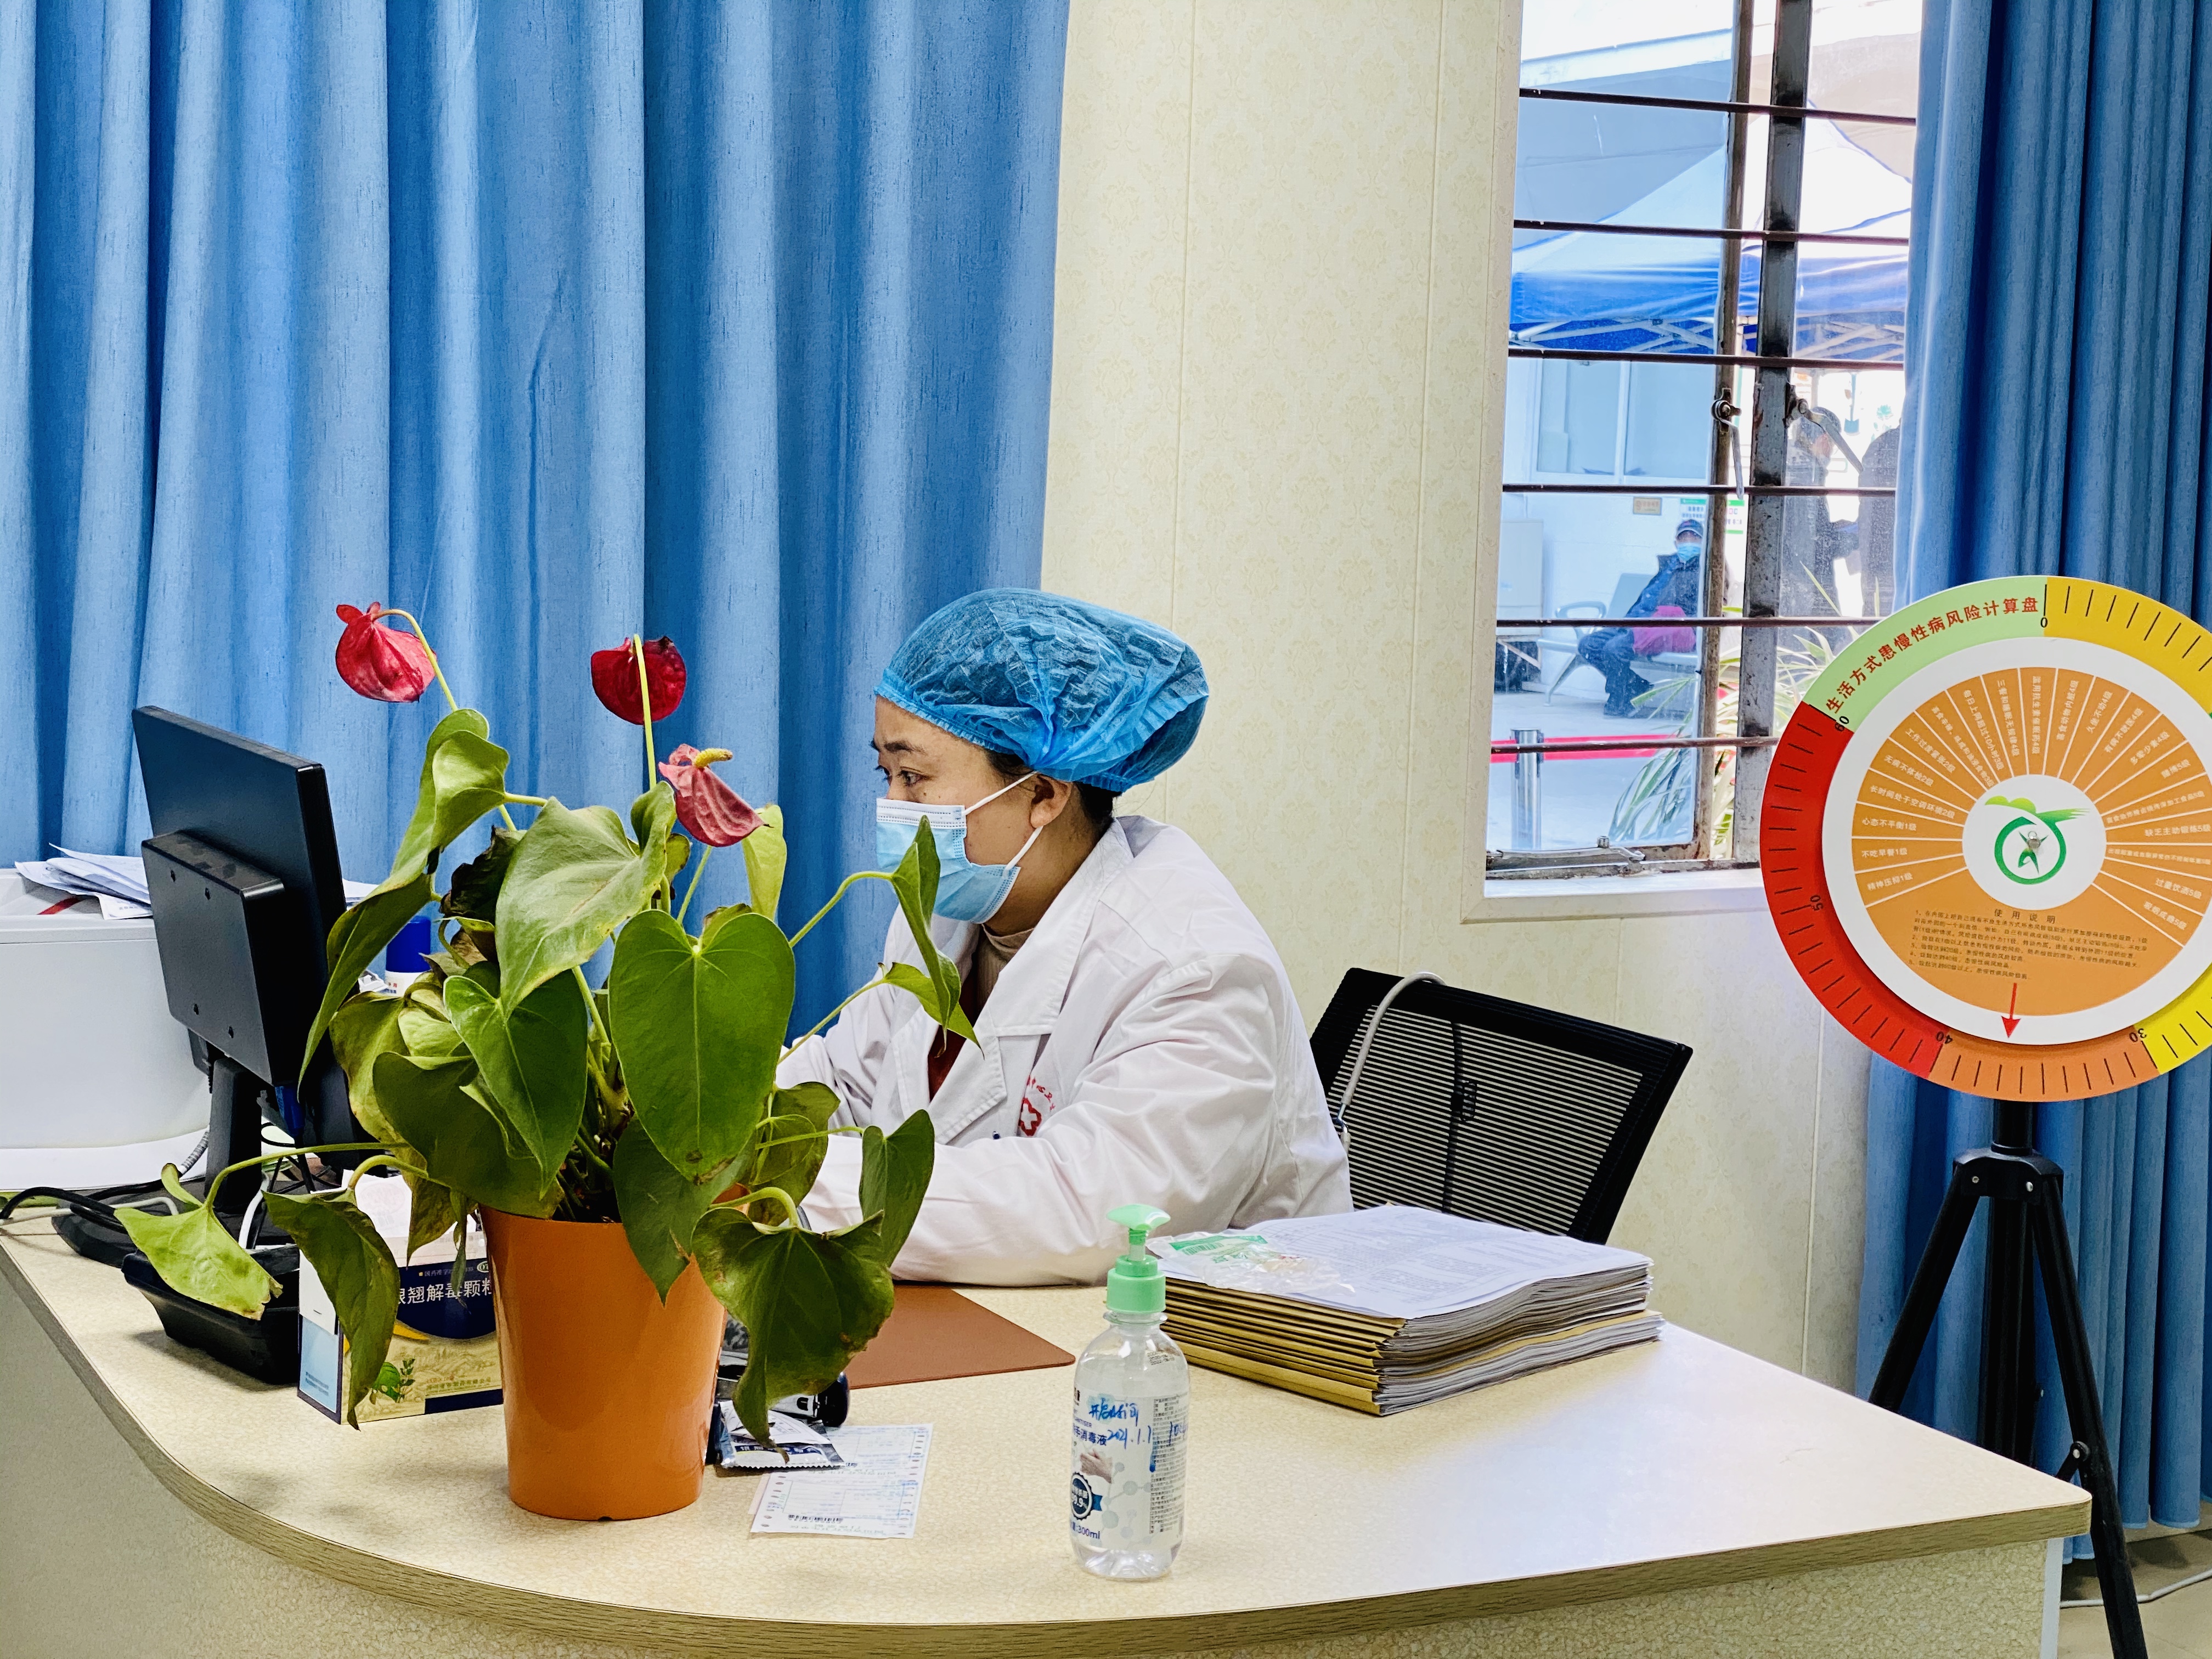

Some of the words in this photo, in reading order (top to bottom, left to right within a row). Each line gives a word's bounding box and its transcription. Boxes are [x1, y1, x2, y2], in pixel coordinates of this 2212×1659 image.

[2040, 617, 2047, 628] 0
[1826, 597, 2038, 713] 生活方式患慢性病风险计算盘
[1835, 715, 1850, 732] 60
[1869, 785, 1955, 819] 长时间处于空调环境2级
[1862, 818, 1917, 831] 心态不平衡1级
[2144, 823, 2211, 837] 缺乏主动锻炼5级
[1861, 848, 1908, 858] 不吃早餐1级
[1866, 872, 1914, 891] 精神压抑1级
[1810, 895, 1824, 911] 50
[1937, 1031, 1953, 1045] 40
[2129, 1028, 2147, 1042] 30
